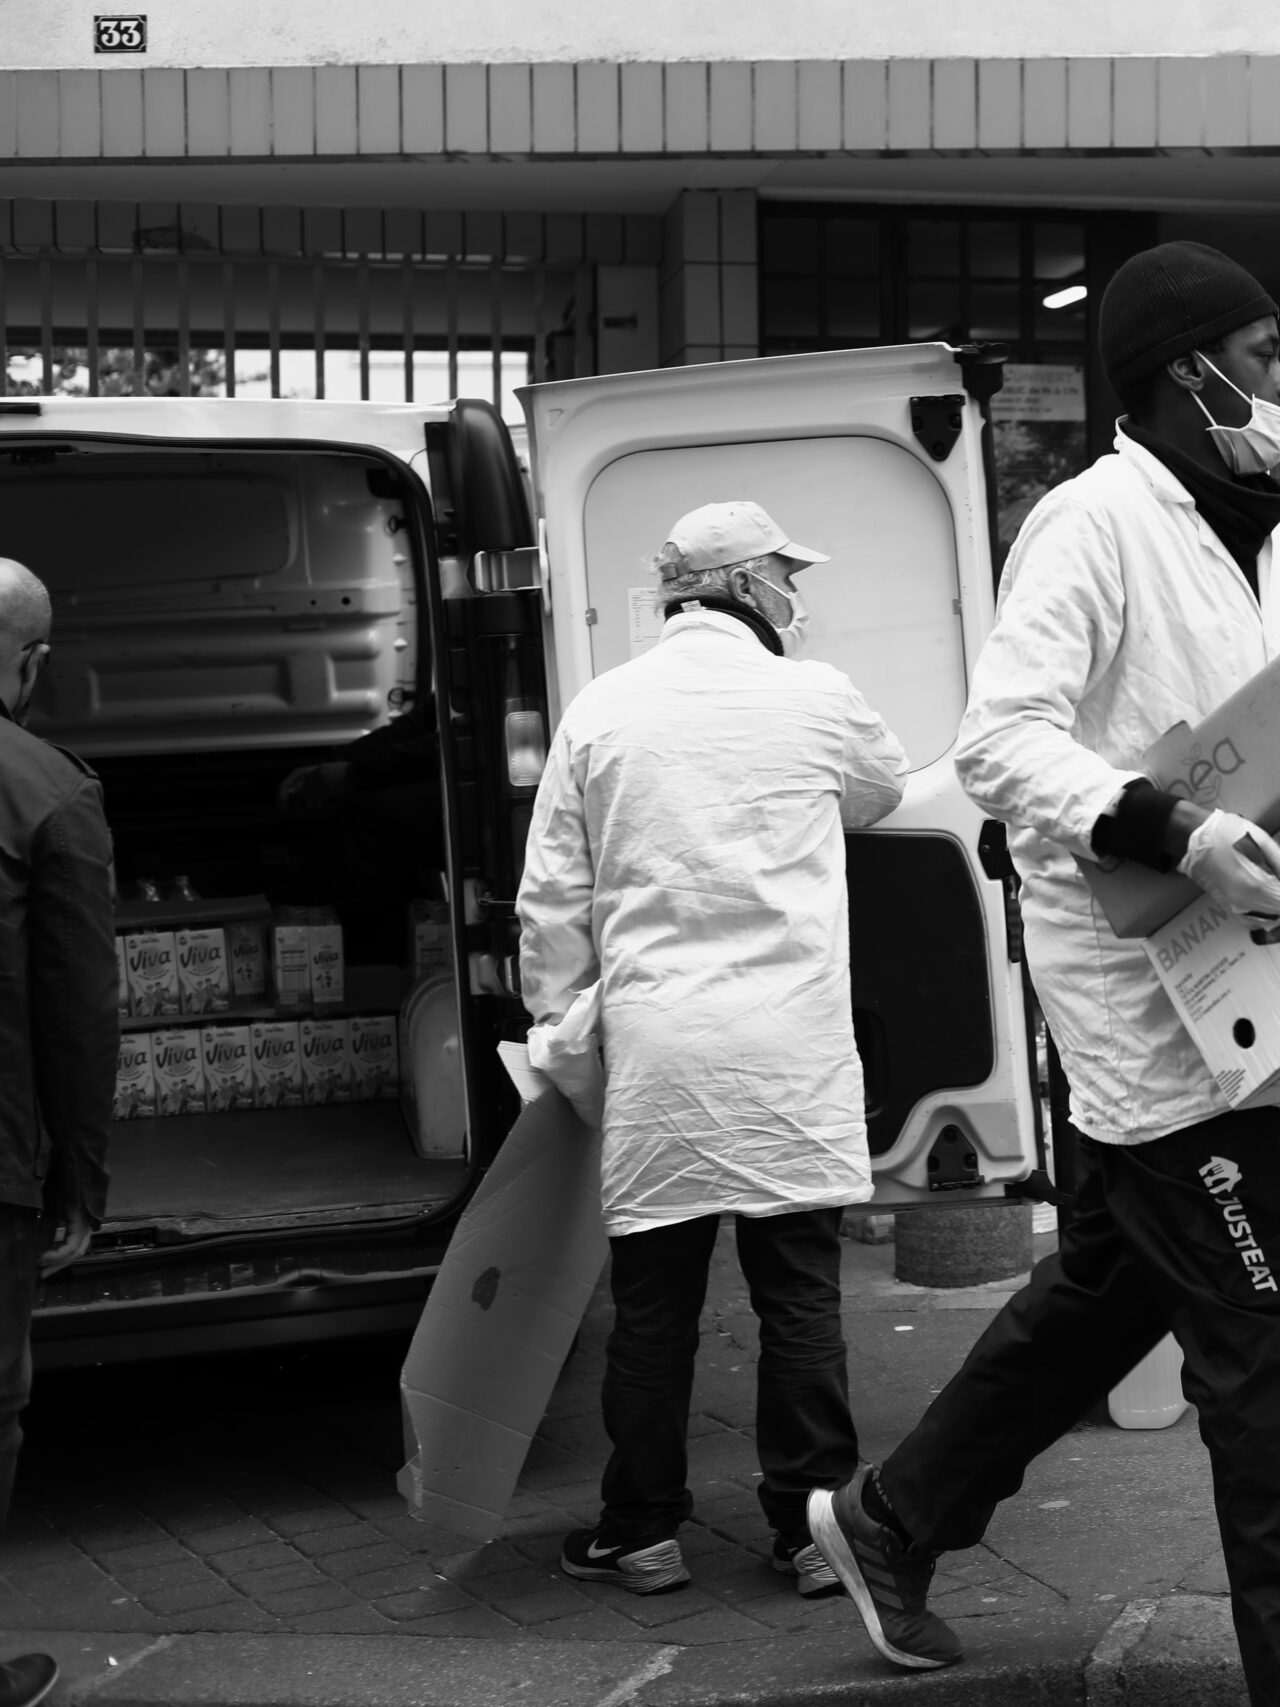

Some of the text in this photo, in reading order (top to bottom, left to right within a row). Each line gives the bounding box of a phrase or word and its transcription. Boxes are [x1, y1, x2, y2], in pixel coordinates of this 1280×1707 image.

[100, 20, 142, 47] 33
[1156, 904, 1230, 973] BANAN
[129, 949, 172, 973] Viva
[179, 945, 221, 969] Viva
[313, 951, 339, 965] Viva
[205, 1043, 248, 1066] Viva
[254, 1038, 296, 1062] Viva
[303, 1036, 345, 1059] Viva
[351, 1031, 393, 1055] Viva
[118, 1051, 148, 1070] iva
[155, 1046, 197, 1070] Viva
